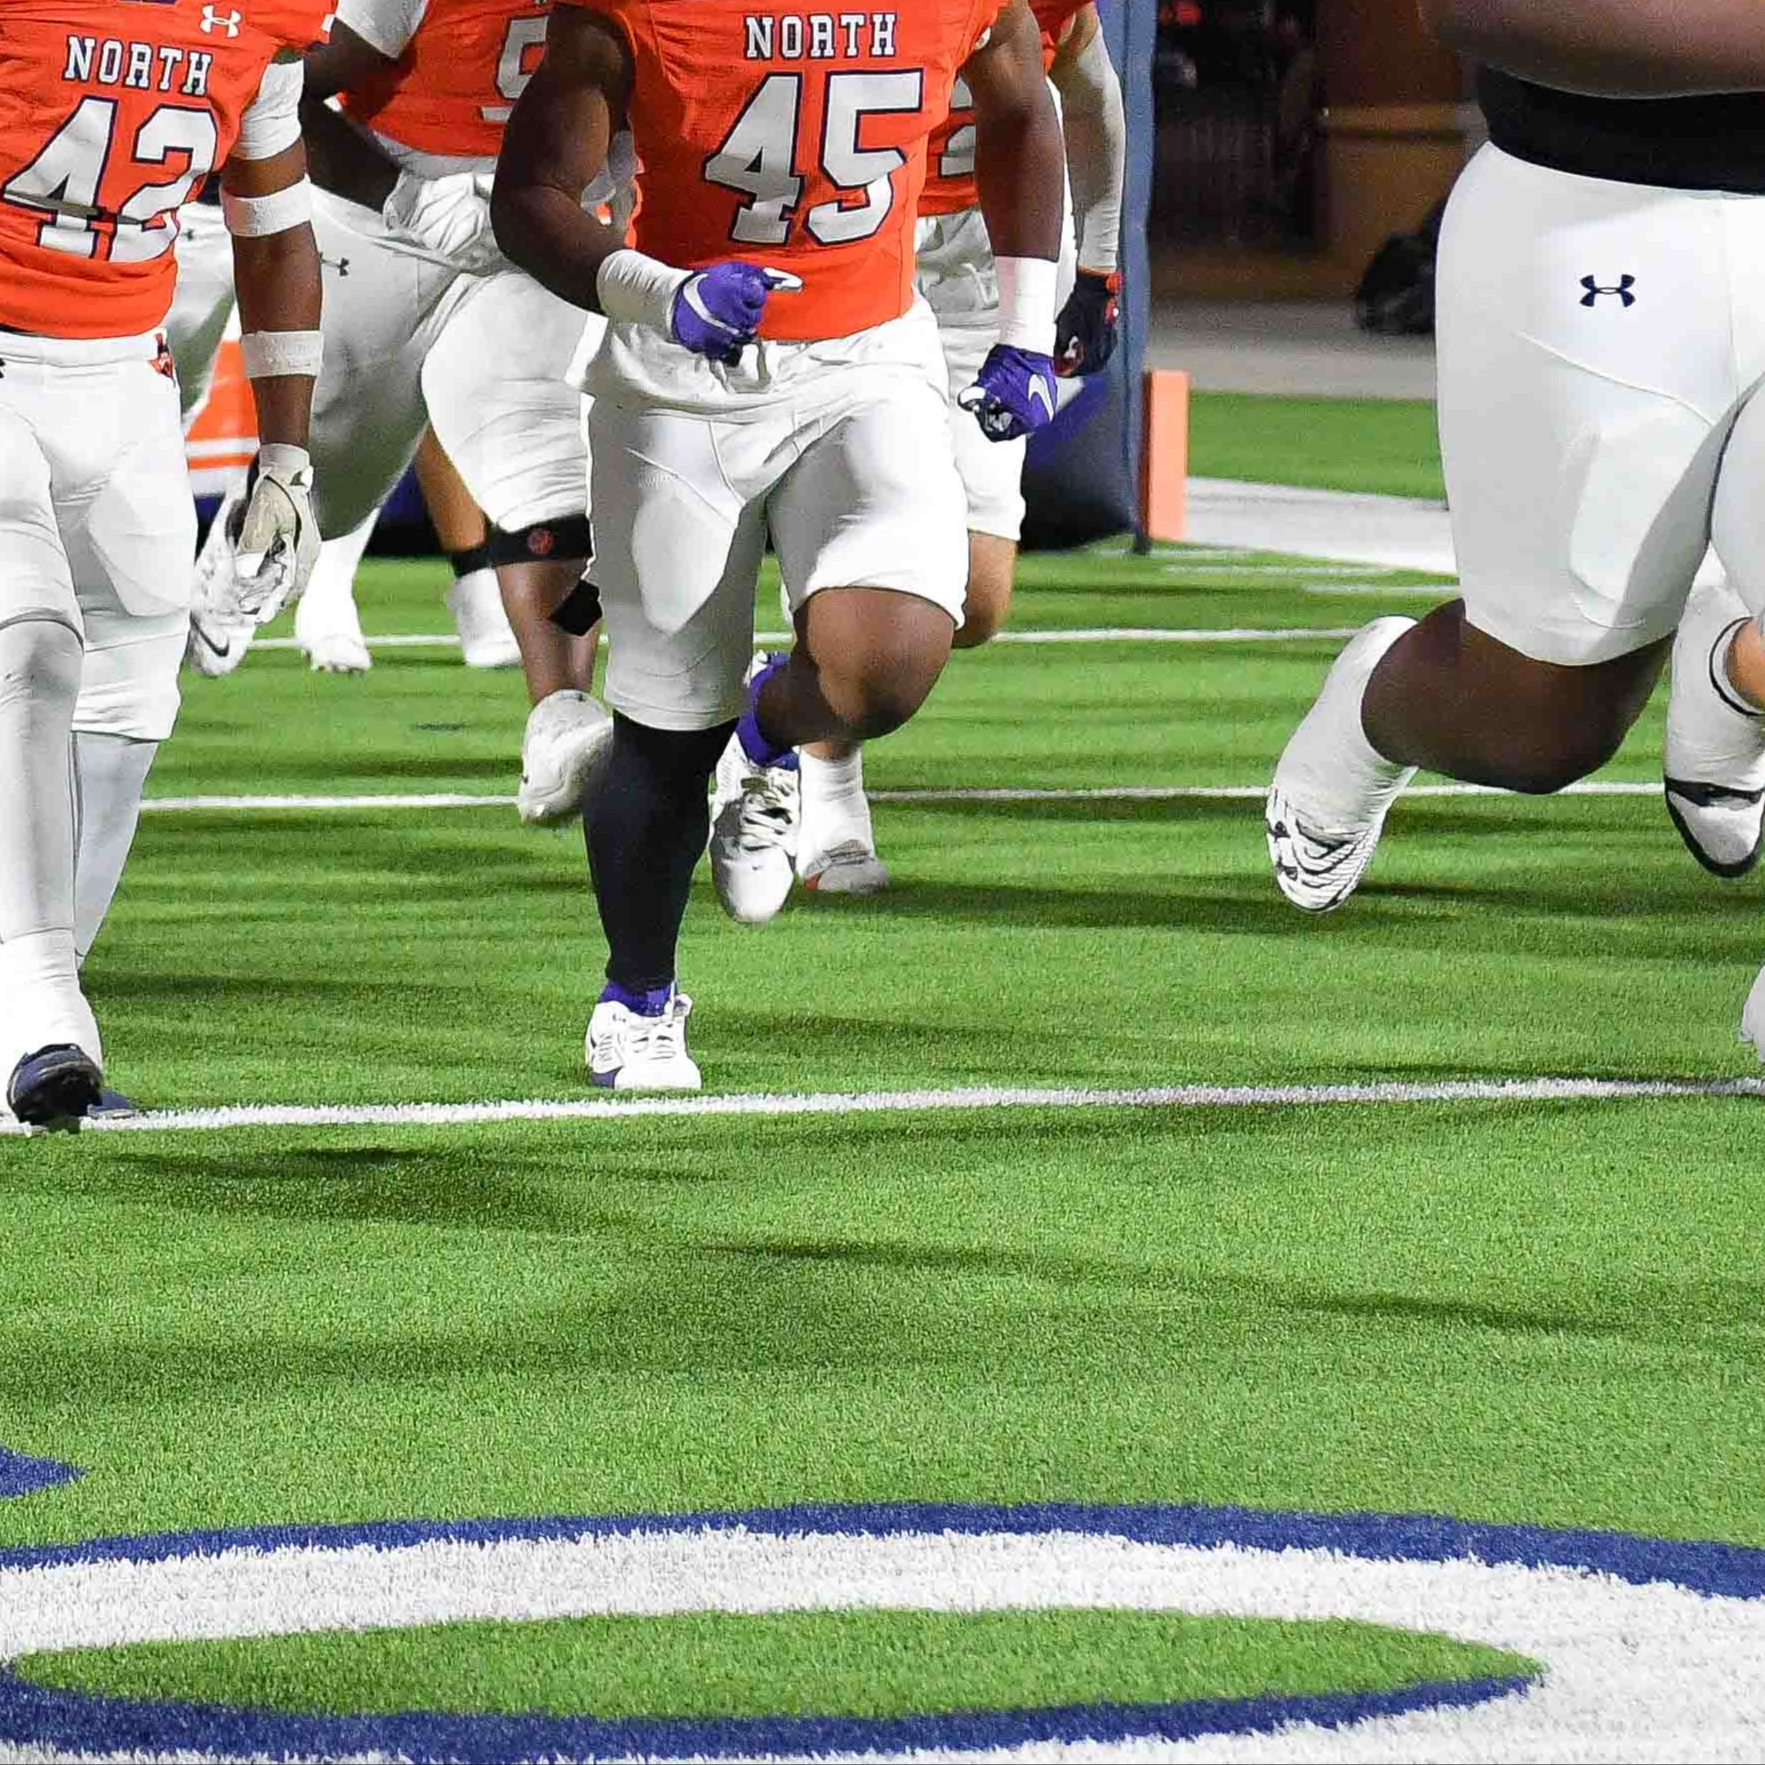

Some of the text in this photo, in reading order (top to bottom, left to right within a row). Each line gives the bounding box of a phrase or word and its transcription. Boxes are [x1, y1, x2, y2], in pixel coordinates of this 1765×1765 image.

[61, 35, 213, 95] NORTH
[744, 12, 897, 59] NORTH
[0, 94, 218, 263] 42
[702, 67, 924, 245] 45
